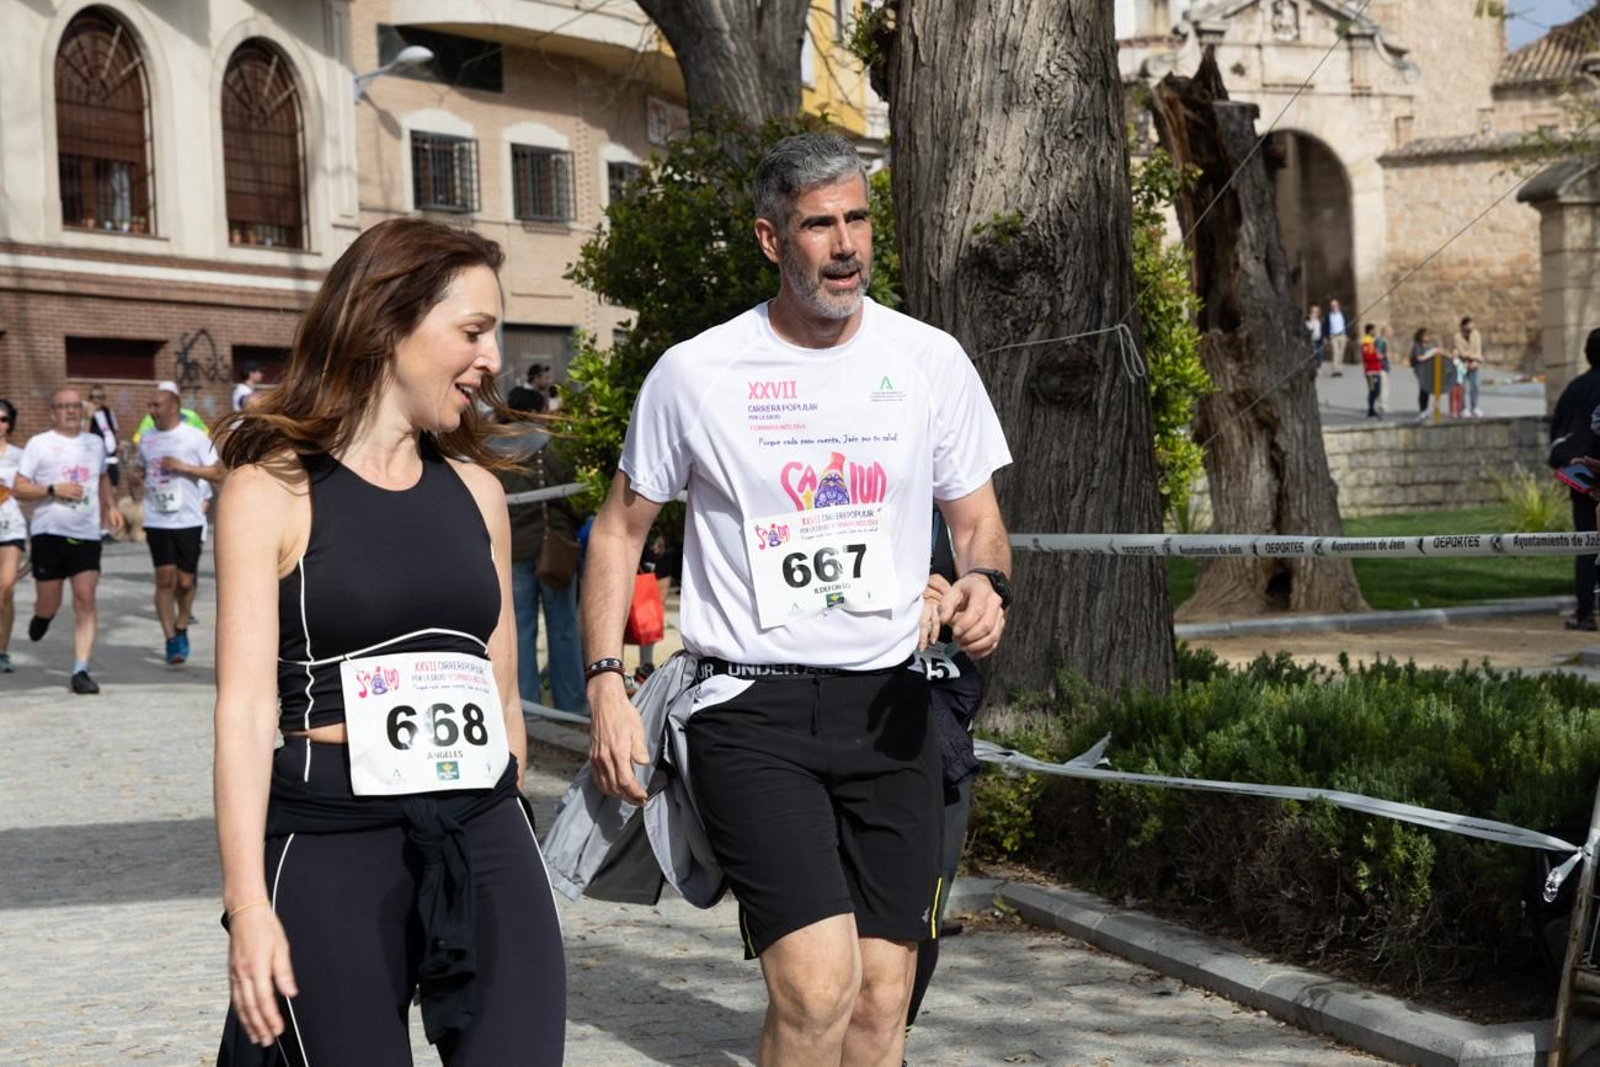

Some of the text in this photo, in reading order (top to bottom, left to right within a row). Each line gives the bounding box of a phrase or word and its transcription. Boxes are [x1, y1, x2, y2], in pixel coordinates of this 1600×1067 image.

[748, 381, 798, 400] XXVII
[748, 402, 818, 413] CARRERA POPULAR
[1264, 541, 1305, 553] DEPORTES
[1331, 540, 1377, 553] Ayuntamiento
[1378, 540, 1387, 551] de
[1433, 535, 1480, 549] DEPORTES
[1513, 534, 1570, 549] Ayuntamiento
[1571, 534, 1583, 547] de
[782, 543, 867, 589] 667
[386, 702, 489, 751] 668
